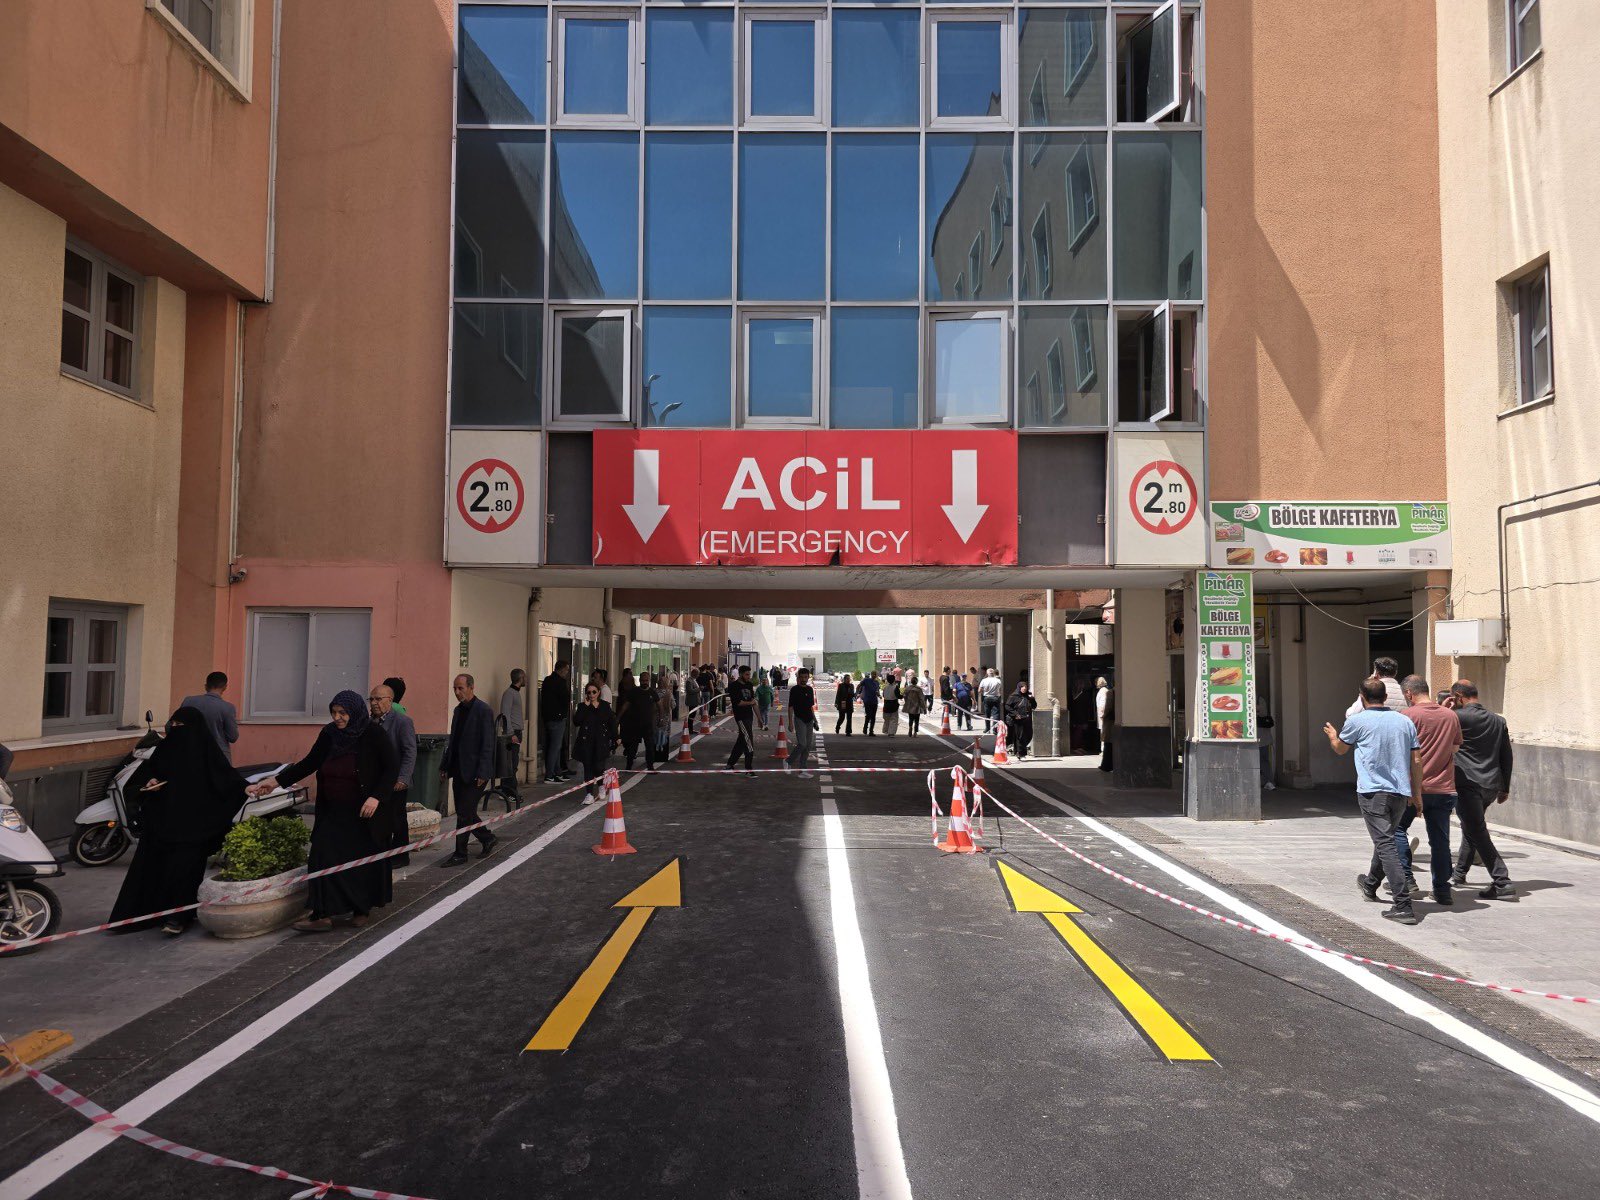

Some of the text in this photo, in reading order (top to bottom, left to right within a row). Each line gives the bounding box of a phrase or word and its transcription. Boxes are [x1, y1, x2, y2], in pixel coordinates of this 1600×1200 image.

[1271, 505, 1316, 526] BÖLGE
[1319, 508, 1398, 526] KAFETERYA
[1210, 609, 1240, 622] BÖLGE
[1200, 625, 1250, 636] KAFETERYA
